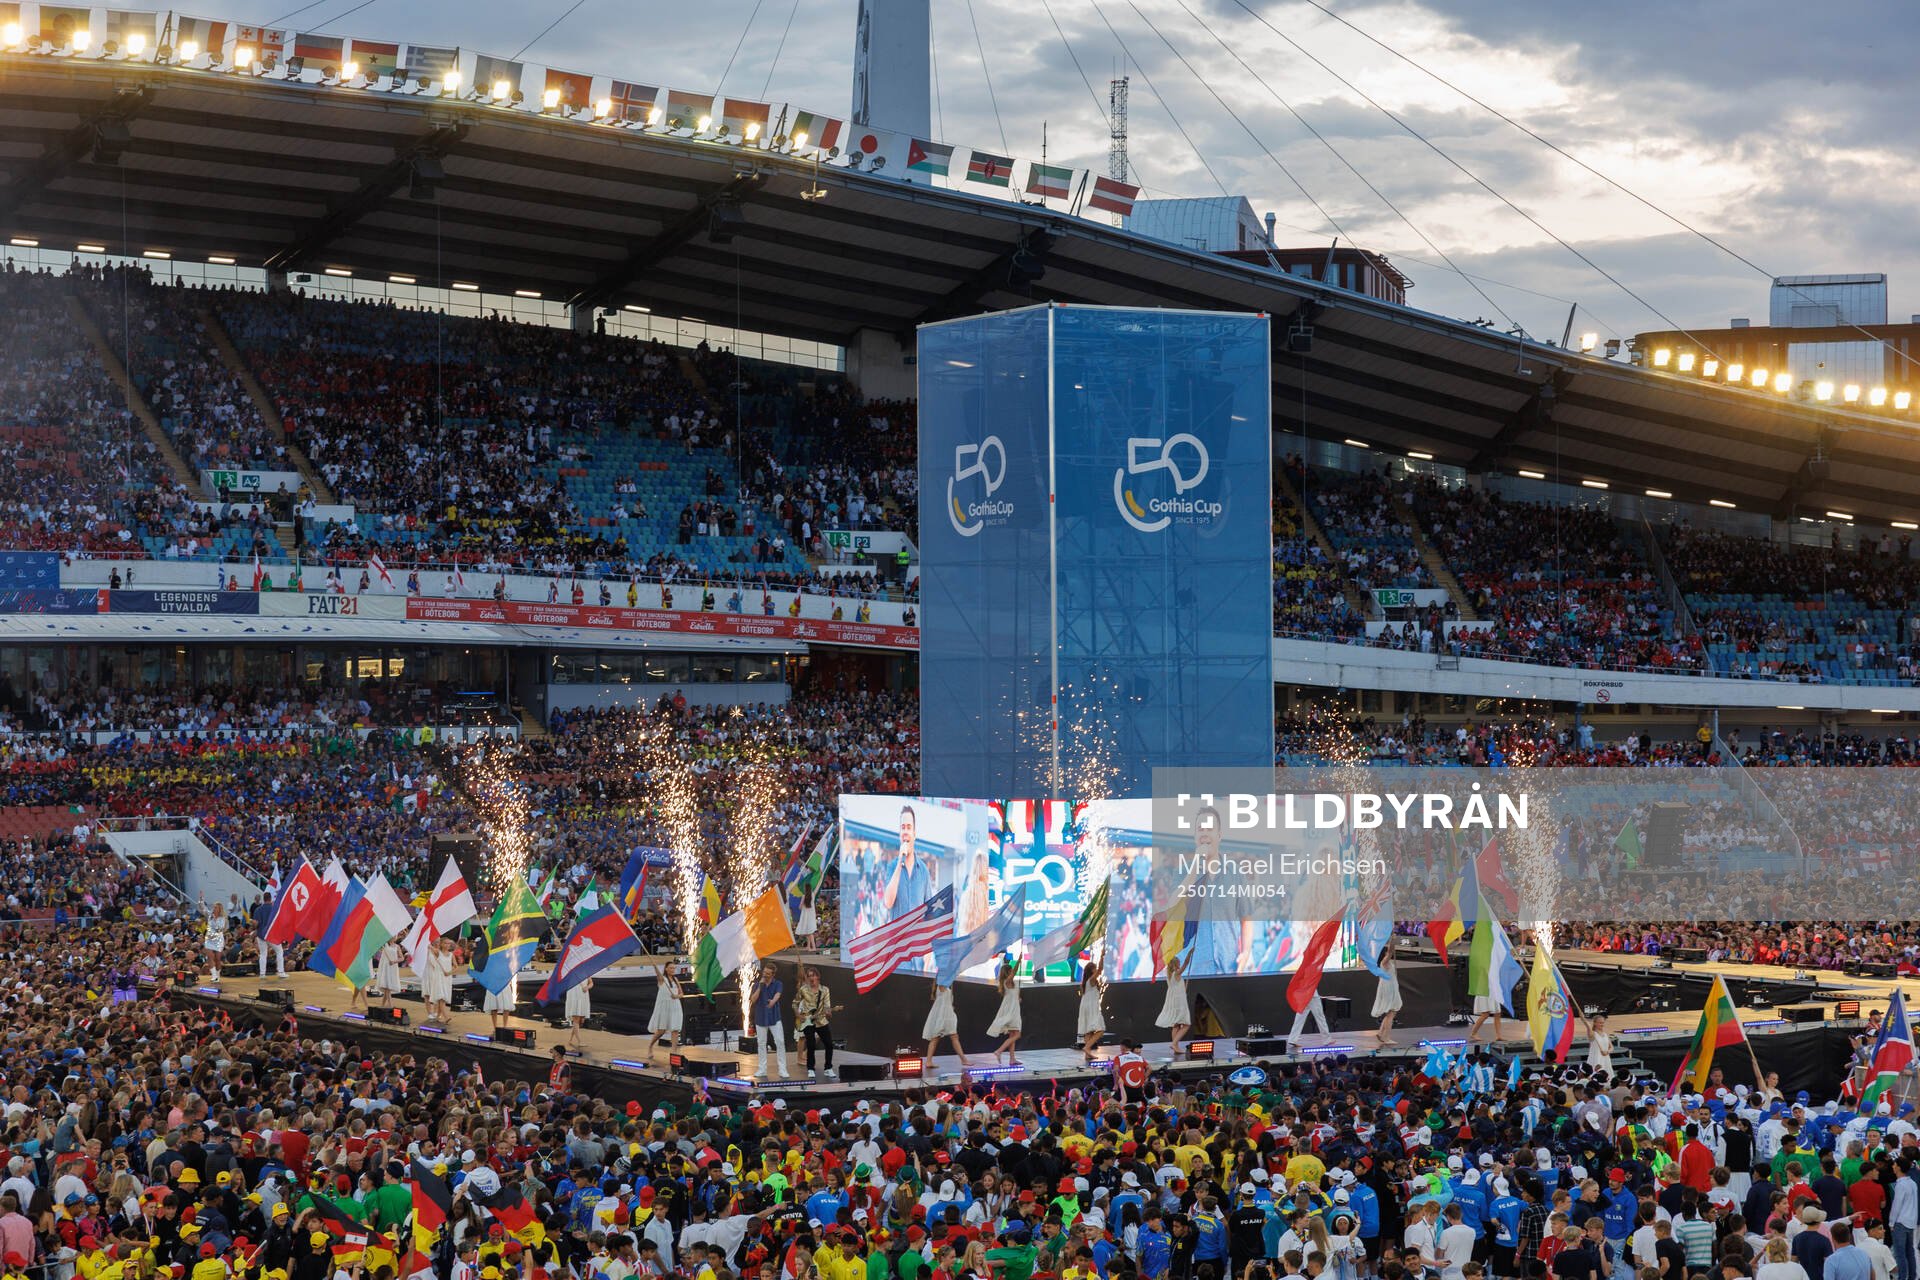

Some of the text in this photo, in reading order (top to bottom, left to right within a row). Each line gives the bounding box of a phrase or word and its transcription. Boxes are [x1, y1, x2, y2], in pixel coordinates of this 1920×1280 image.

[956, 435, 1006, 497] 50
[1128, 433, 1209, 495] 50
[243, 476, 259, 487] A2
[968, 500, 1014, 517] Gothia Cup
[1149, 498, 1222, 517] Gothia Cup
[154, 592, 218, 602] LEGENDENS
[1401, 593, 1413, 603] C2
[161, 603, 211, 612] UTVALDA
[308, 595, 358, 615] FAT21
[425, 608, 460, 618] GÖTEBORG
[533, 613, 568, 623] GÖTEBORG
[636, 619, 671, 629] GÖTEBORG
[741, 625, 774, 634] GÖTEBORG
[842, 632, 876, 642] GÖTEBORG
[1583, 680, 1624, 688] RÖKFÖRBUD
